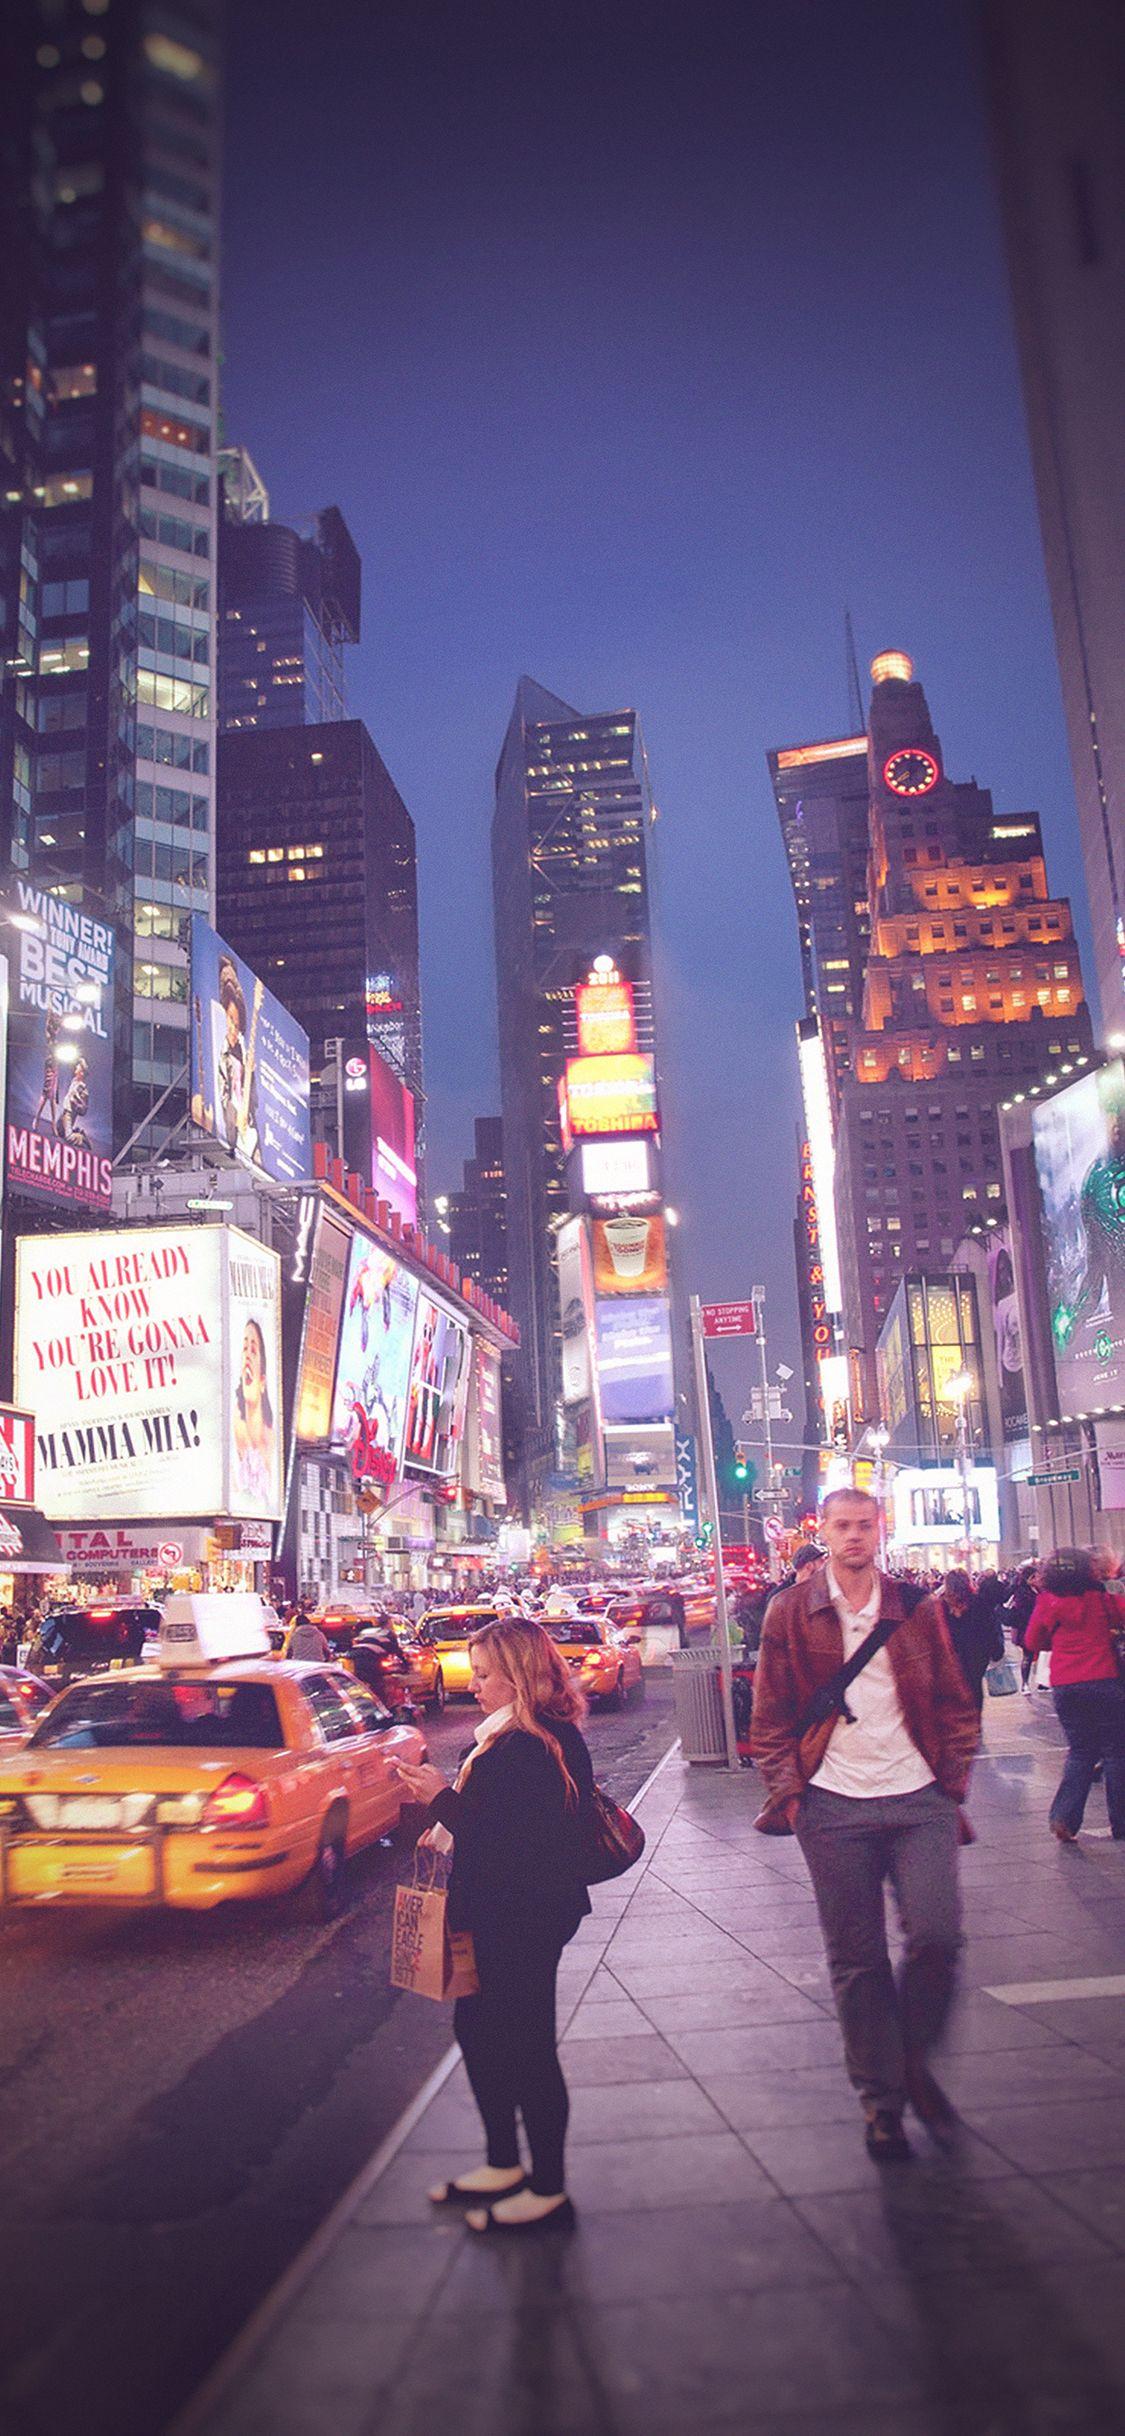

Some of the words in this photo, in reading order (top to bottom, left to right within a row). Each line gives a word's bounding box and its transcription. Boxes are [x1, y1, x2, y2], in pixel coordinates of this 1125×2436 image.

[17, 881, 113, 955] WINNER!
[20, 931, 109, 1009] BEST
[20, 982, 108, 1039] MUSICAL
[572, 1114, 658, 1134] TOSHIBA
[8, 1123, 112, 1196] MEMPHIS
[802, 1141, 819, 1244] ERNST
[31, 1265, 78, 1300] YOU
[88, 1244, 191, 1292] ALREADY
[810, 1263, 825, 1285] &
[80, 1288, 151, 1328] KNOW
[714, 1315, 742, 1324] ANYTIME
[717, 1305, 749, 1315] STOPPING
[32, 1328, 121, 1371] YOU'RE
[128, 1314, 211, 1355] GONNA
[75, 1361, 138, 1401] LOVE
[143, 1354, 177, 1390] IT!
[37, 1421, 136, 1472] MAMMA
[141, 1409, 201, 1456] MIA!
[674, 1439, 695, 1531] TRYX
[66, 1547, 158, 1561] COMPUTERS
